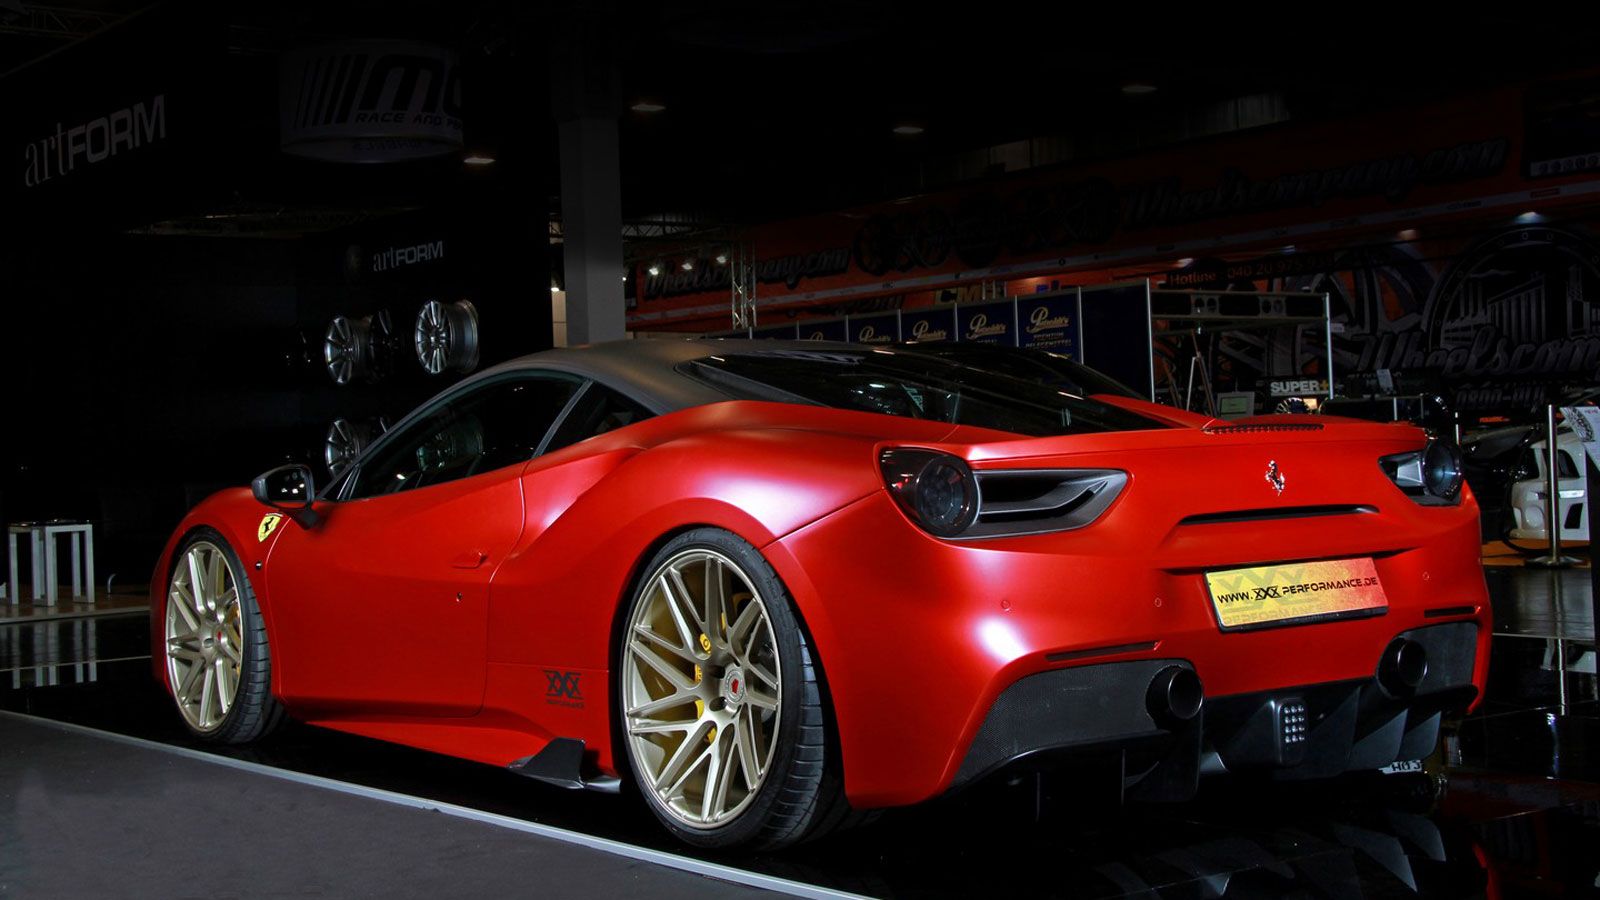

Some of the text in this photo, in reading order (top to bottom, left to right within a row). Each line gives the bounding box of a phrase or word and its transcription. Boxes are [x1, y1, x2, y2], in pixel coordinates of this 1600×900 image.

[355, 112, 405, 124] RACE
[412, 114, 443, 127] AND
[25, 94, 167, 188] artFORM
[1122, 138, 1509, 226] Wheelscompany.com
[373, 240, 444, 272] artFORM
[1169, 271, 1217, 286] Hotline
[1226, 264, 1253, 279] 040
[1256, 263, 1273, 275] 20
[1217, 592, 1254, 604] WWW.
[1283, 577, 1378, 594] PERFORMANCE.DE
